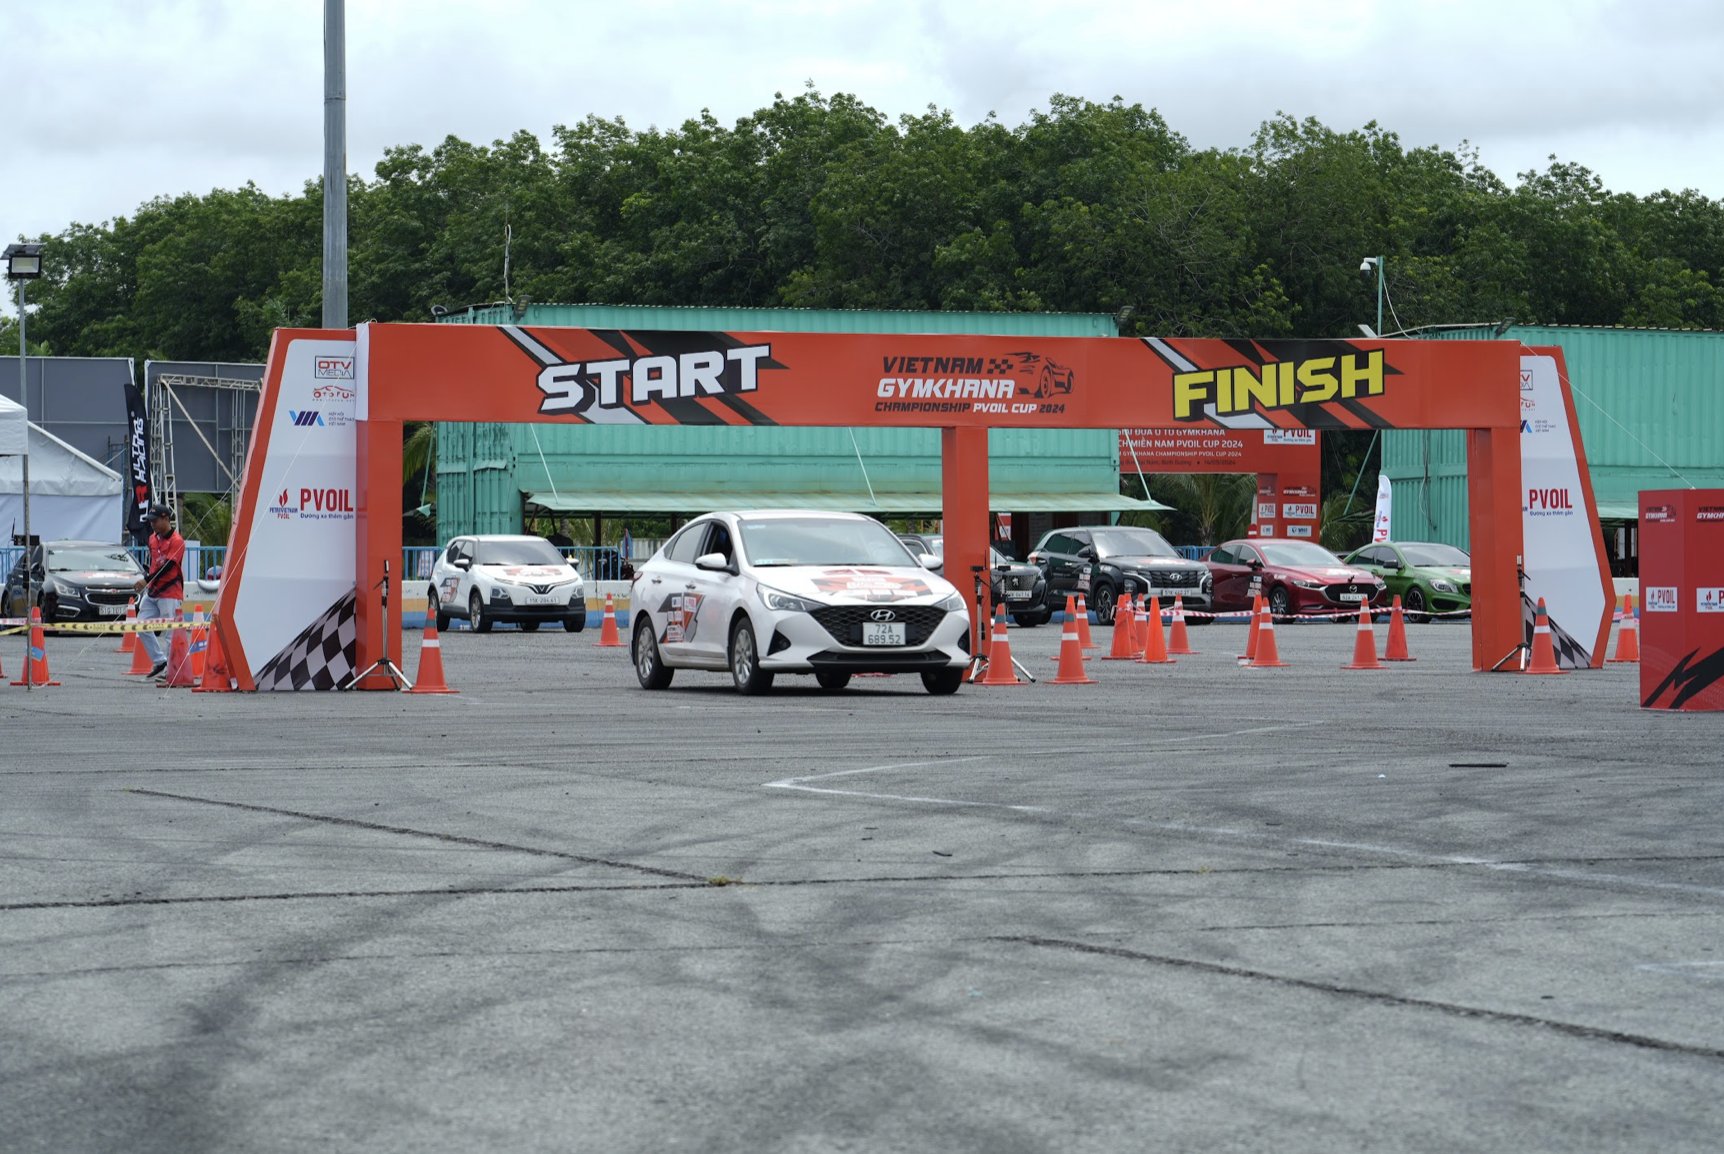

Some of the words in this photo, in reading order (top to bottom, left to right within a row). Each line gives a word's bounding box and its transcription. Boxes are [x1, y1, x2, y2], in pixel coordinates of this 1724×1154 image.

[318, 360, 352, 370] OTV
[882, 356, 985, 375] VIETNAM
[537, 345, 770, 411] START
[1174, 350, 1384, 419] FINISH
[876, 377, 1016, 400] GYMKHANA
[874, 401, 971, 413] CHAMPIONSHIP
[972, 402, 1009, 414] PVOIL
[1011, 402, 1038, 414] CUP
[1038, 403, 1066, 414] 2024
[1154, 439, 1174, 448] NAM
[1176, 440, 1201, 448] PVOIL
[1202, 440, 1220, 448] CUP
[1221, 440, 1243, 449] 2024
[300, 488, 354, 512] PVOIL
[1529, 488, 1573, 509] PVOIL
[1295, 504, 1315, 515] PVOIL
[1657, 590, 1675, 604] PVOIL
[875, 624, 893, 634] 72A
[868, 635, 901, 645] 689.52
